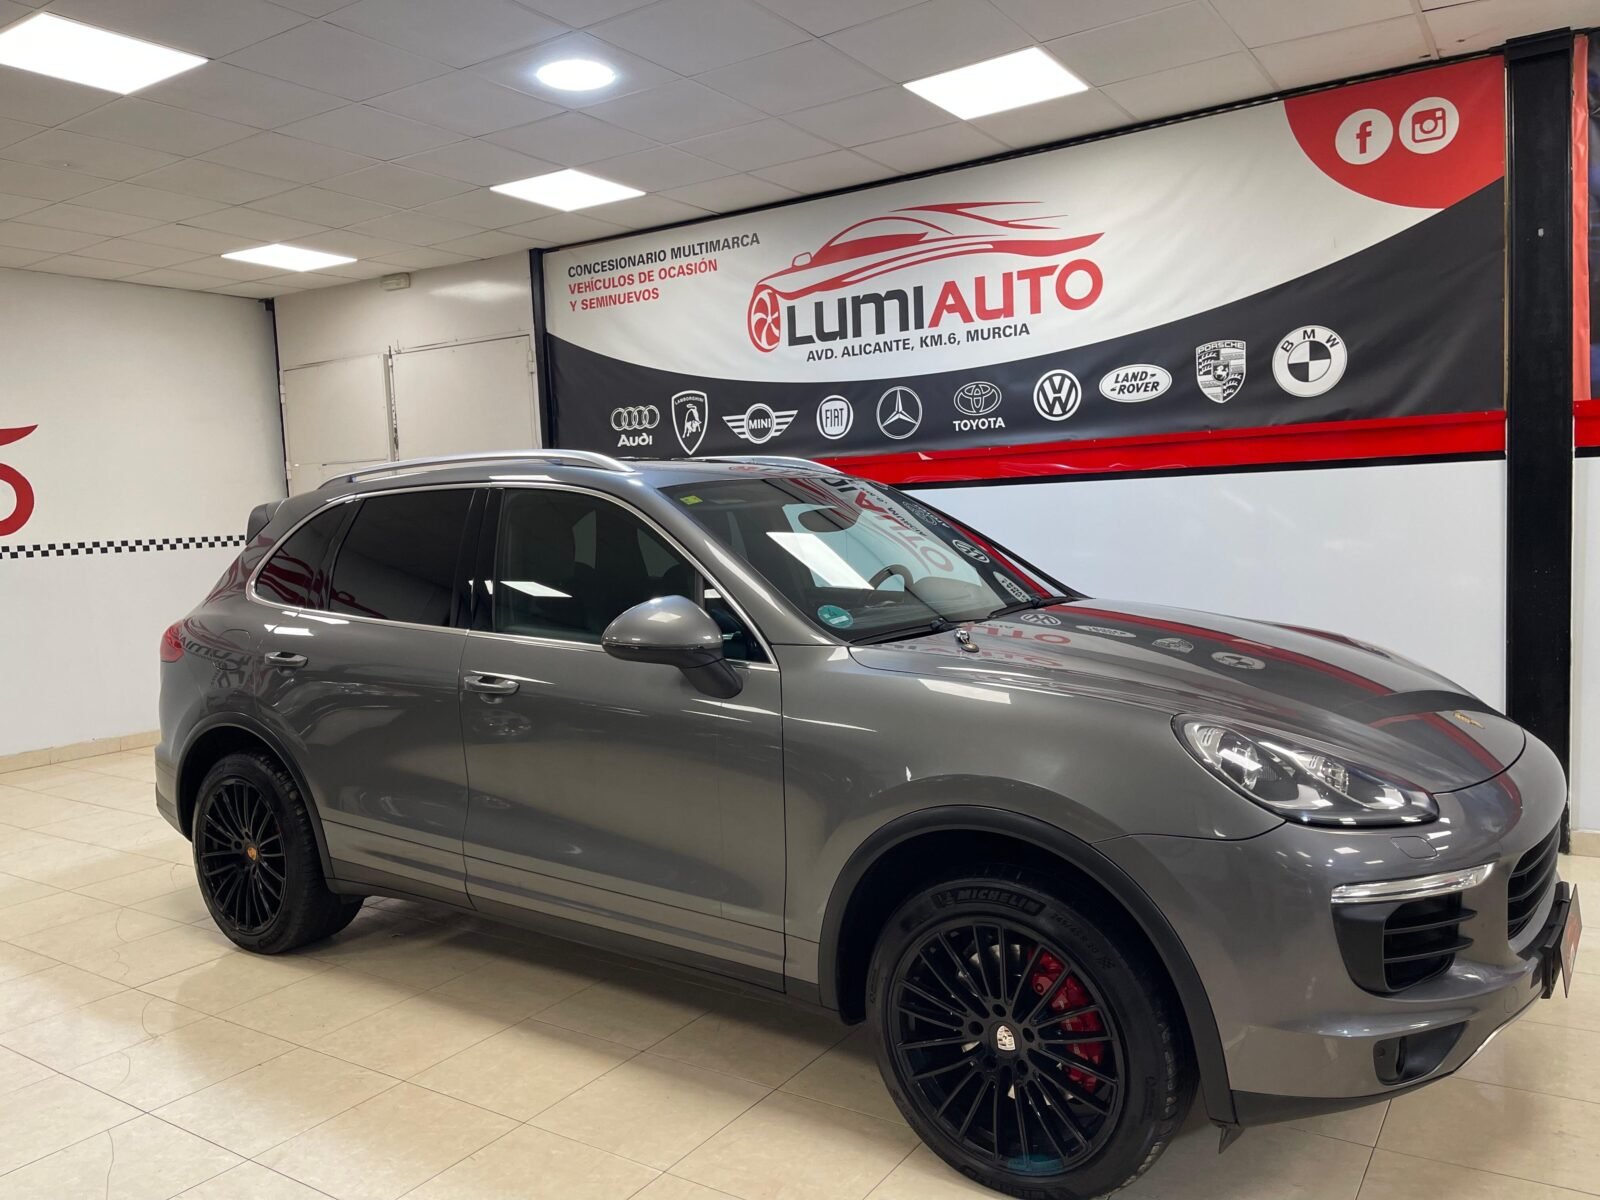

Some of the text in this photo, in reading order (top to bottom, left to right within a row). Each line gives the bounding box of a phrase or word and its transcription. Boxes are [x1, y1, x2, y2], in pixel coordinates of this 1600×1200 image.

[568, 233, 760, 278] CONCESIONARIO MULTIMARCA
[568, 258, 718, 295] VEHÍCULOS DE OCASIÓN
[569, 287, 660, 312] Y SEMINUEVOS
[806, 322, 1030, 362] AVD. ALICANTE, KM.6, MURCIA
[748, 418, 772, 430] MINI
[823, 407, 845, 428] FIAT
[952, 417, 1005, 432] TOYOTA
[617, 433, 653, 447] Audi
[956, 887, 1042, 914] MICHELIN
